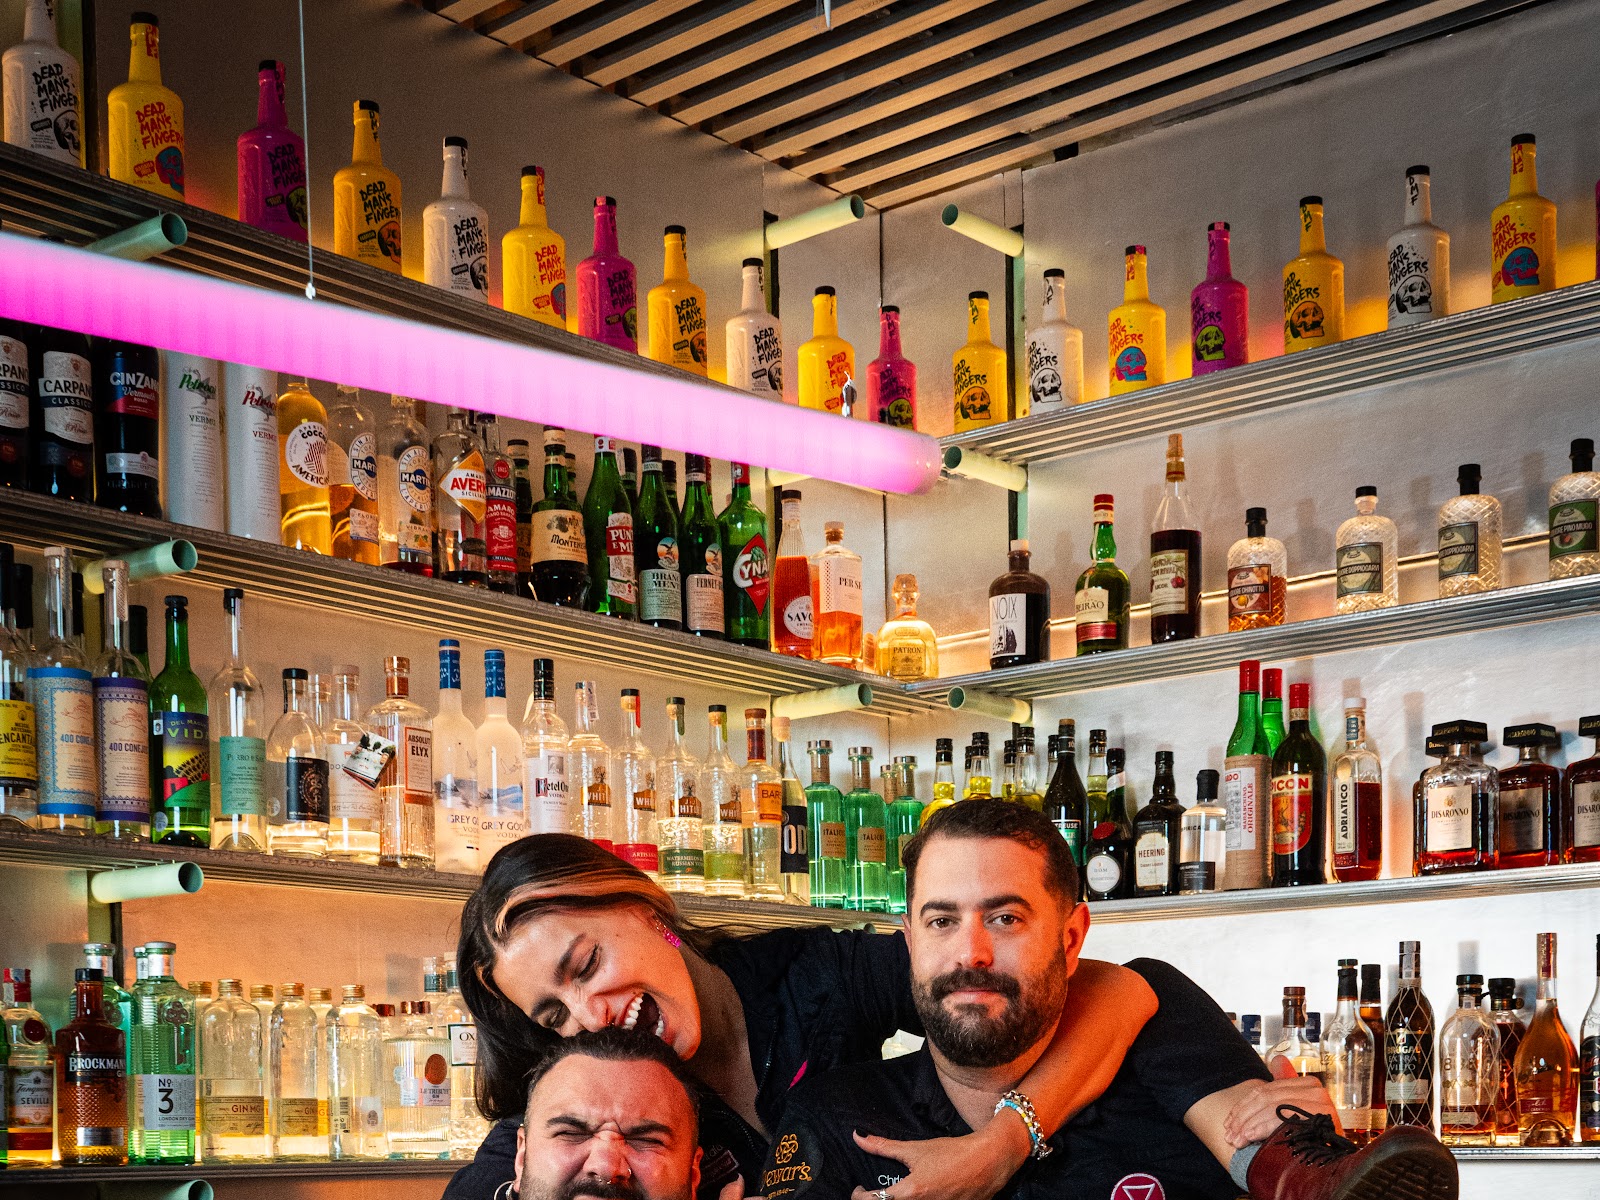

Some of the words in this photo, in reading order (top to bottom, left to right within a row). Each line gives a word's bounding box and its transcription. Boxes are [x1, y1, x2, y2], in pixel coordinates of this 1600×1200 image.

[32, 63, 64, 86] DEAD
[37, 76, 70, 98] MAN'S
[136, 101, 165, 123] DEAD
[140, 114, 172, 136] MAN'S
[267, 143, 295, 160] DEAD
[359, 181, 386, 202] DEAD
[1408, 177, 1418, 206] DMF
[363, 192, 392, 214] MAN'S
[454, 217, 479, 236] DEAD
[457, 228, 483, 247] MAN'S
[535, 245, 558, 262] DEAD
[1495, 232, 1537, 262] FINGERS
[538, 256, 561, 274] MAN'S
[607, 269, 629, 288] DEAD
[675, 297, 697, 315] DEAD
[678, 306, 701, 325] MAN'S
[753, 327, 774, 344] DEAD
[756, 337, 778, 353] MAN'S
[839, 577, 853, 587] PER
[993, 596, 1018, 619] NOIX
[60, 734, 74, 743] 400
[109, 743, 123, 752] 400
[411, 746, 429, 757] ELYX
[1431, 808, 1468, 819] DISARONNO
[1503, 809, 1540, 821] DISARONNO
[481, 821, 505, 831] GREY
[1138, 848, 1165, 858] HEERING
[158, 1088, 174, 1114] 3
[231, 1104, 249, 1113] GIN
